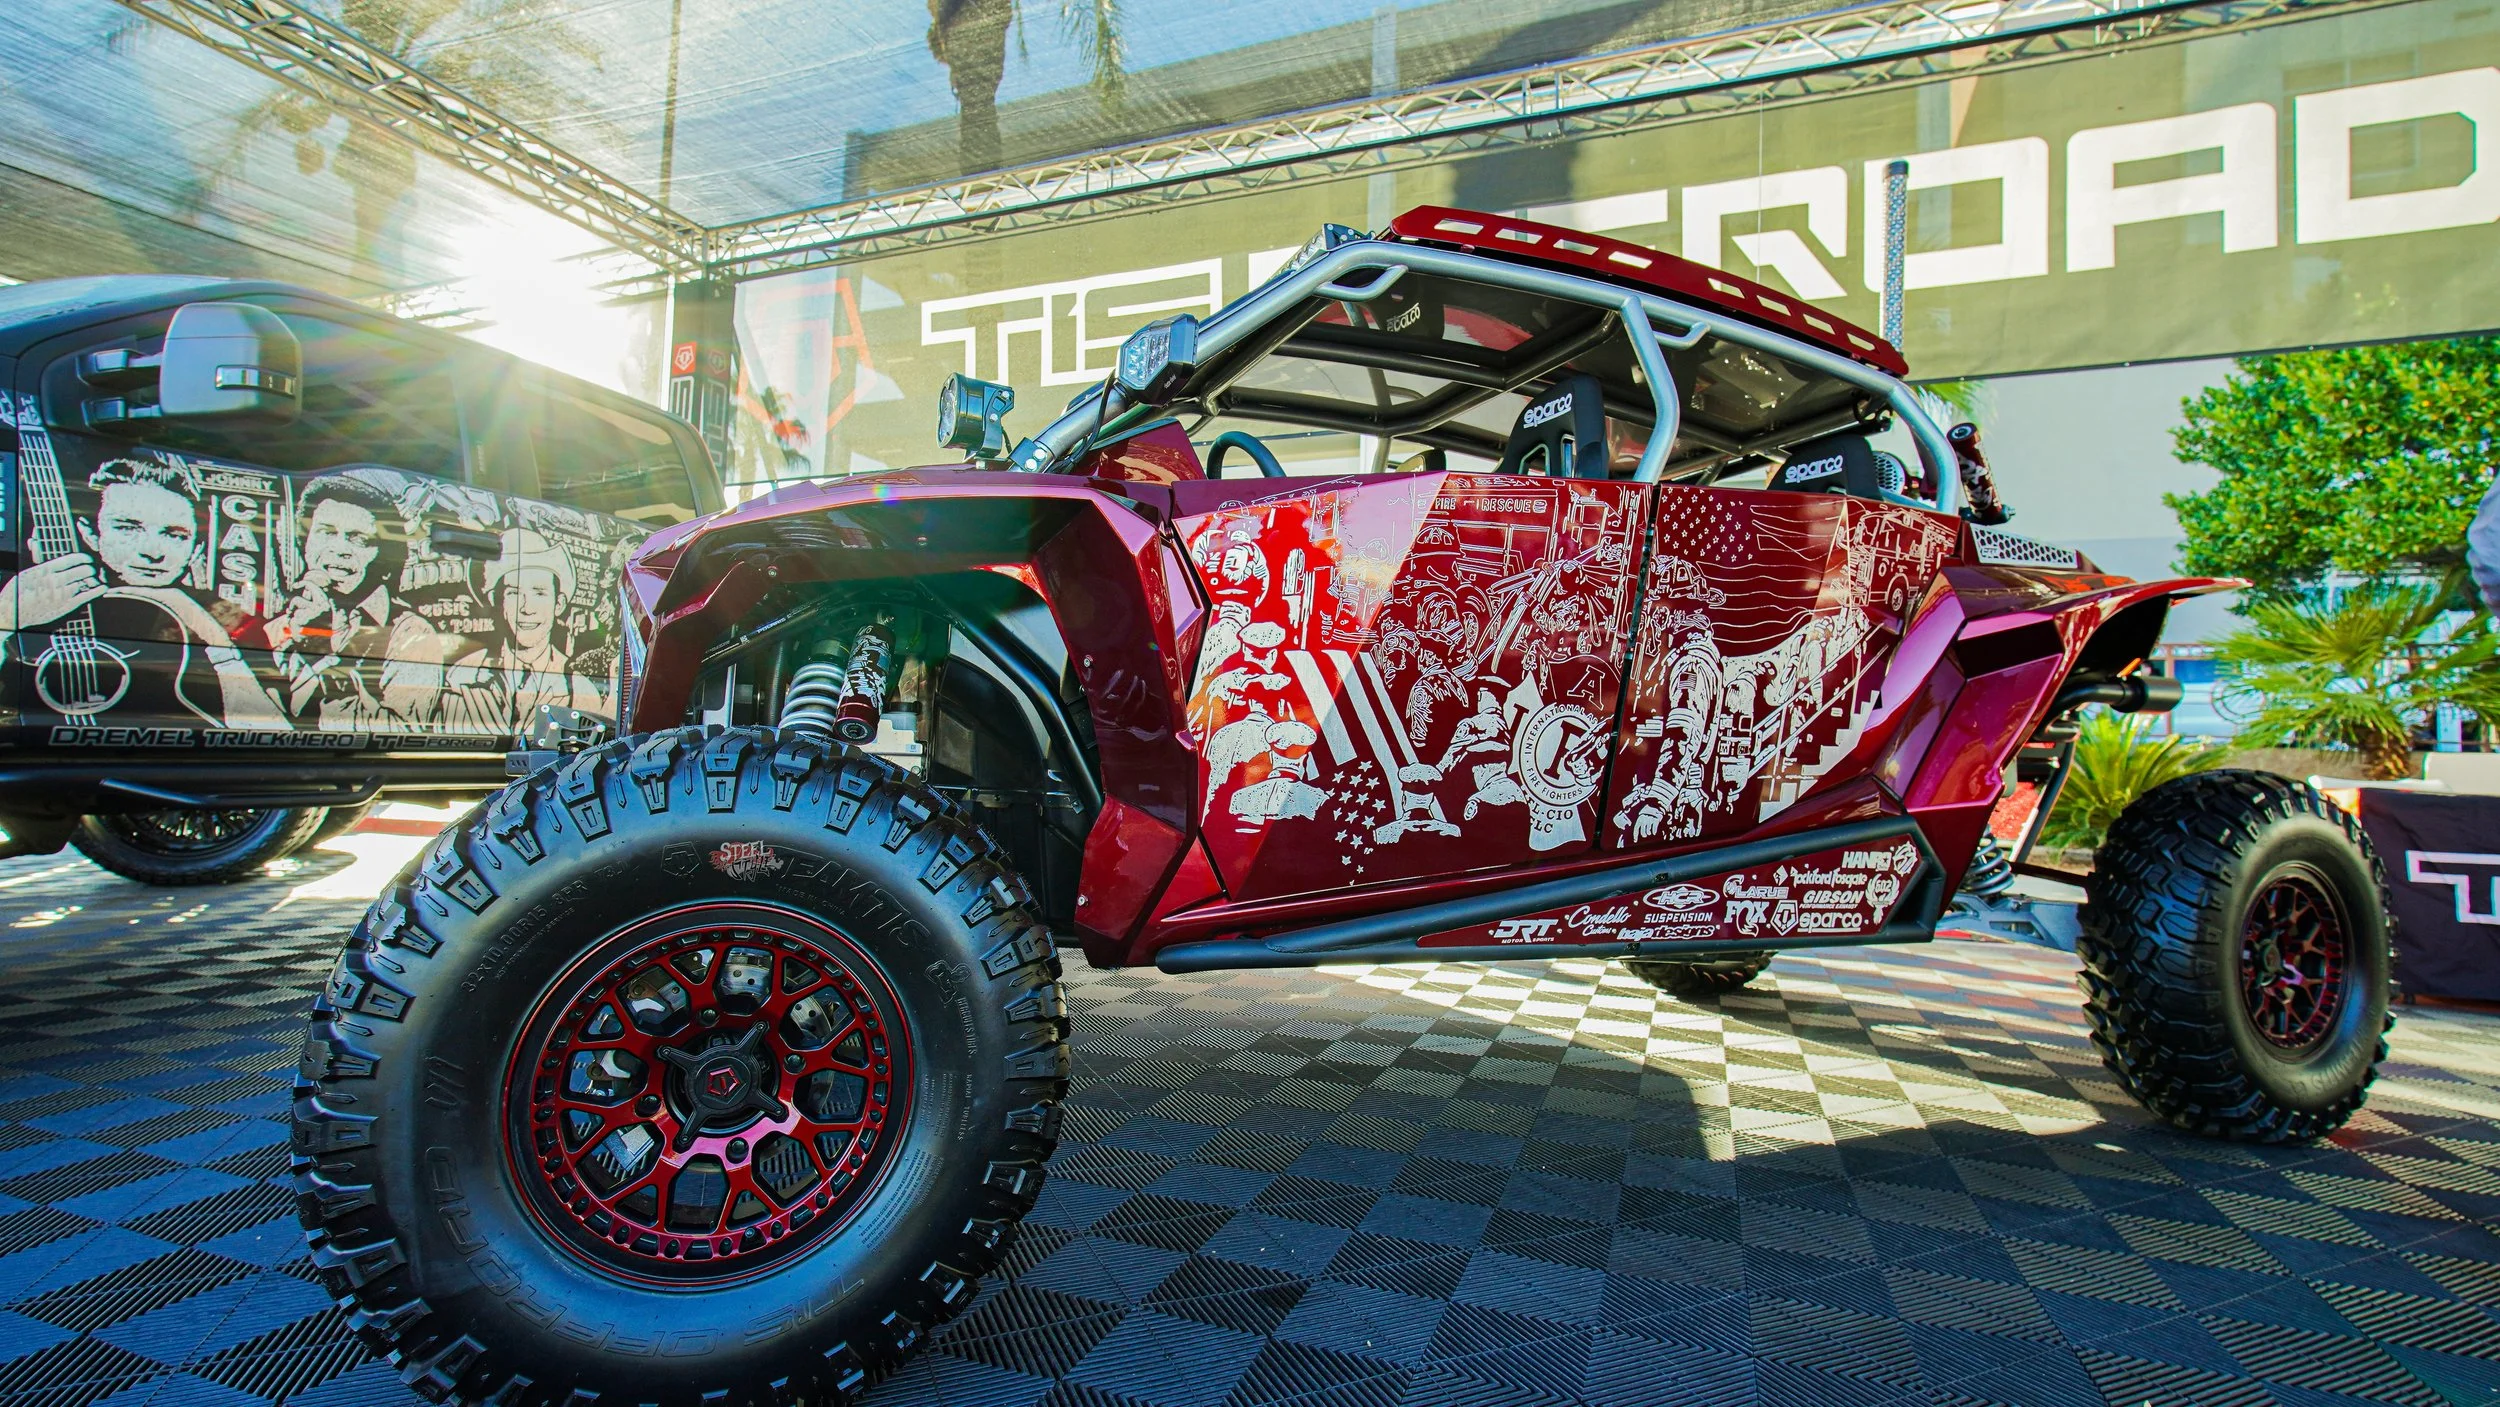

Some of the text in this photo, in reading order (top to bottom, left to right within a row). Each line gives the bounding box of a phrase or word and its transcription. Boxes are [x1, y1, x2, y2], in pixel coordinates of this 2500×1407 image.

[921, 258, 1223, 388] TIS
[1523, 393, 1573, 428] sparco
[1785, 455, 1844, 483] sparco
[206, 473, 273, 490] JOHNNY
[1434, 497, 1531, 513] FIRE RESCUE
[218, 495, 261, 616] CASH
[49, 726, 195, 748] DREMEL
[371, 732, 426, 750] TIS
[425, 735, 497, 750] FORGED
[1524, 704, 1586, 755] INTERNATIONAL
[1526, 767, 1584, 801] FIRE FIGHTERS
[720, 840, 771, 862] STEEL
[1657, 890, 1705, 905] HCR
[1803, 890, 1865, 904] GIBSON
[1566, 904, 1632, 928] Condello
[1643, 911, 1713, 924] SUSPENSION
[1724, 900, 1770, 936] FOX
[1797, 911, 1864, 933] sparco
[1493, 918, 1559, 943] DRT
